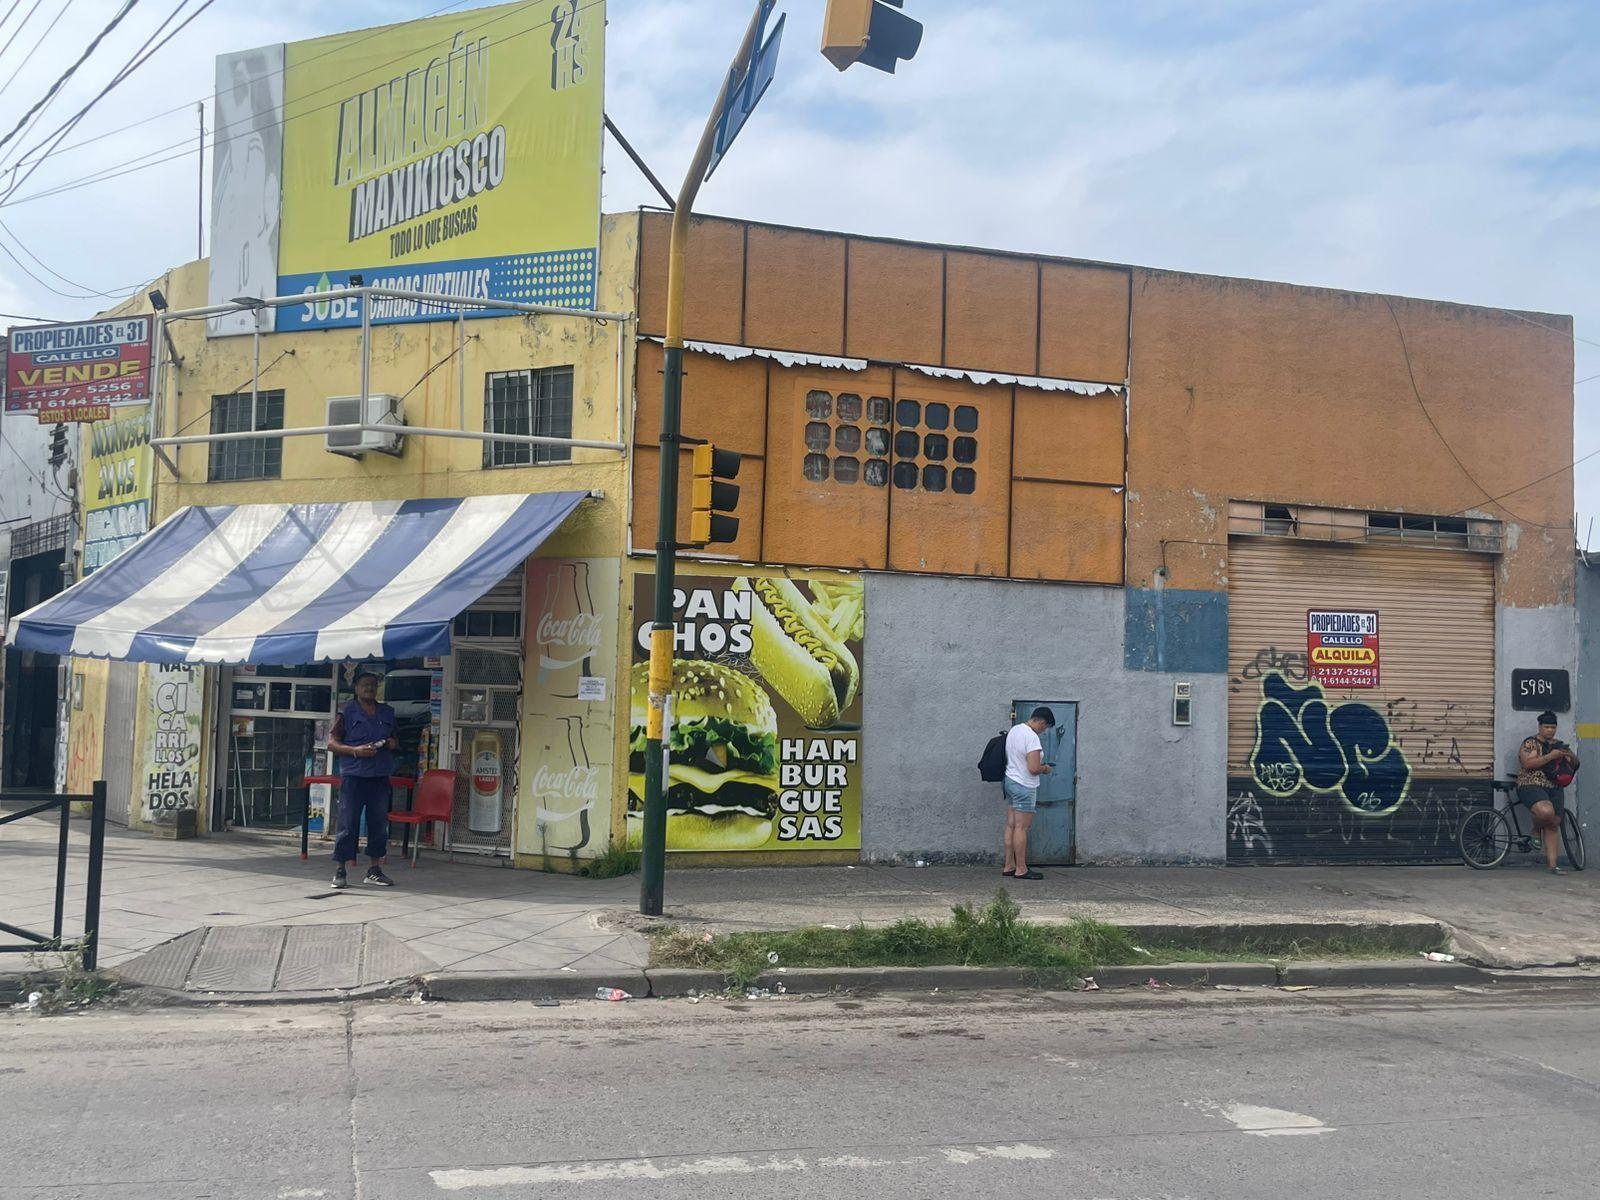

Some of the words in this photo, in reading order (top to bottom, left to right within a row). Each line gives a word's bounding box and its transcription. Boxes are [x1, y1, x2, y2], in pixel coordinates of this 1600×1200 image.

[551, 0, 585, 51] 24
[551, 41, 592, 91] HS
[334, 31, 491, 186] ALMACÉN
[349, 125, 506, 243] MAXIKIOSCO
[390, 227, 412, 259] TODO
[413, 224, 424, 251] LO
[425, 218, 442, 249] QUE
[443, 204, 478, 241] BUSCAS
[301, 282, 359, 322] SUBE
[421, 268, 490, 315] VIRTUALES
[15, 324, 113, 353] PROPIEDADES
[116, 327, 125, 337] EL
[127, 320, 144, 341] 31
[36, 348, 116, 363] CALELLO
[17, 360, 141, 386] VENDE
[25, 401, 42, 410] 11
[48, 397, 87, 408] 6144
[92, 392, 132, 405] 5442
[28, 387, 70, 398] 2137
[87, 382, 131, 394] 5256
[41, 408, 64, 422] ESTOS
[66, 407, 72, 421] 3
[74, 405, 108, 420] LOCALES
[1311, 614, 1360, 633] PROPIEDADES
[1366, 616, 1375, 633] 31
[637, 622, 753, 653] CHOS
[1322, 636, 1363, 644] CALELLO
[1315, 649, 1372, 661] ALQUILA
[1318, 668, 1371, 676] 2137-5256
[156, 682, 188, 713] CI
[1520, 679, 1552, 695] 5984
[157, 712, 187, 731] GA
[156, 731, 187, 748] RRI
[781, 738, 857, 762] HAM
[155, 749, 184, 764] LLOS
[148, 771, 192, 790] HELA
[779, 764, 848, 788] BUR
[149, 791, 190, 810] DOS
[777, 789, 842, 813] GUE
[777, 815, 844, 841] SAS
